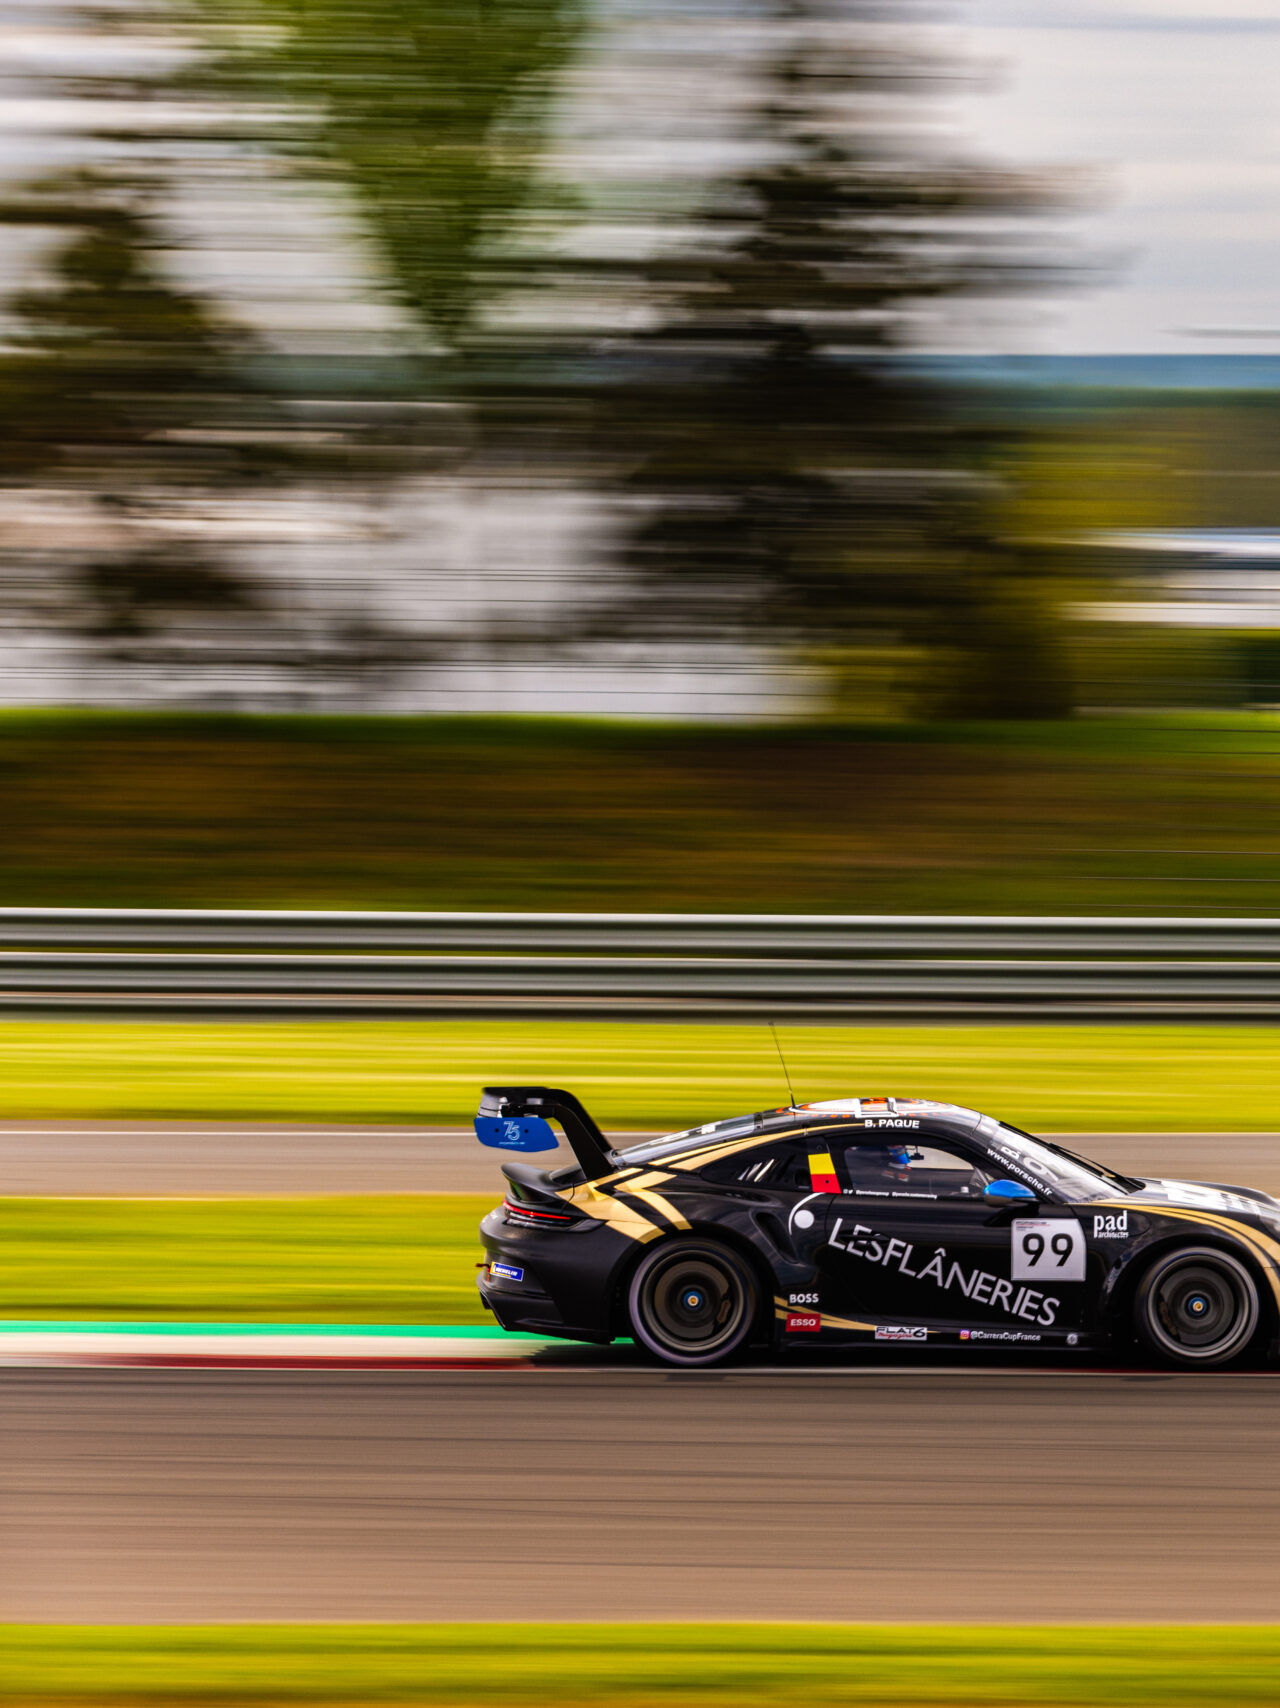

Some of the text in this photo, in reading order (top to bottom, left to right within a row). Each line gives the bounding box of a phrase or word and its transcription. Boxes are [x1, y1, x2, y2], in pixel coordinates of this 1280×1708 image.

[864, 1119, 920, 1129] B. PAQUE
[986, 1147, 1053, 1196] www.porsche.fr
[1093, 1210, 1128, 1239] pad
[1022, 1233, 1073, 1267] 99
[789, 1293, 819, 1303] BOSS
[790, 1318, 816, 1327] ESSO
[970, 1330, 1041, 1342] @CarreraCupFrance
